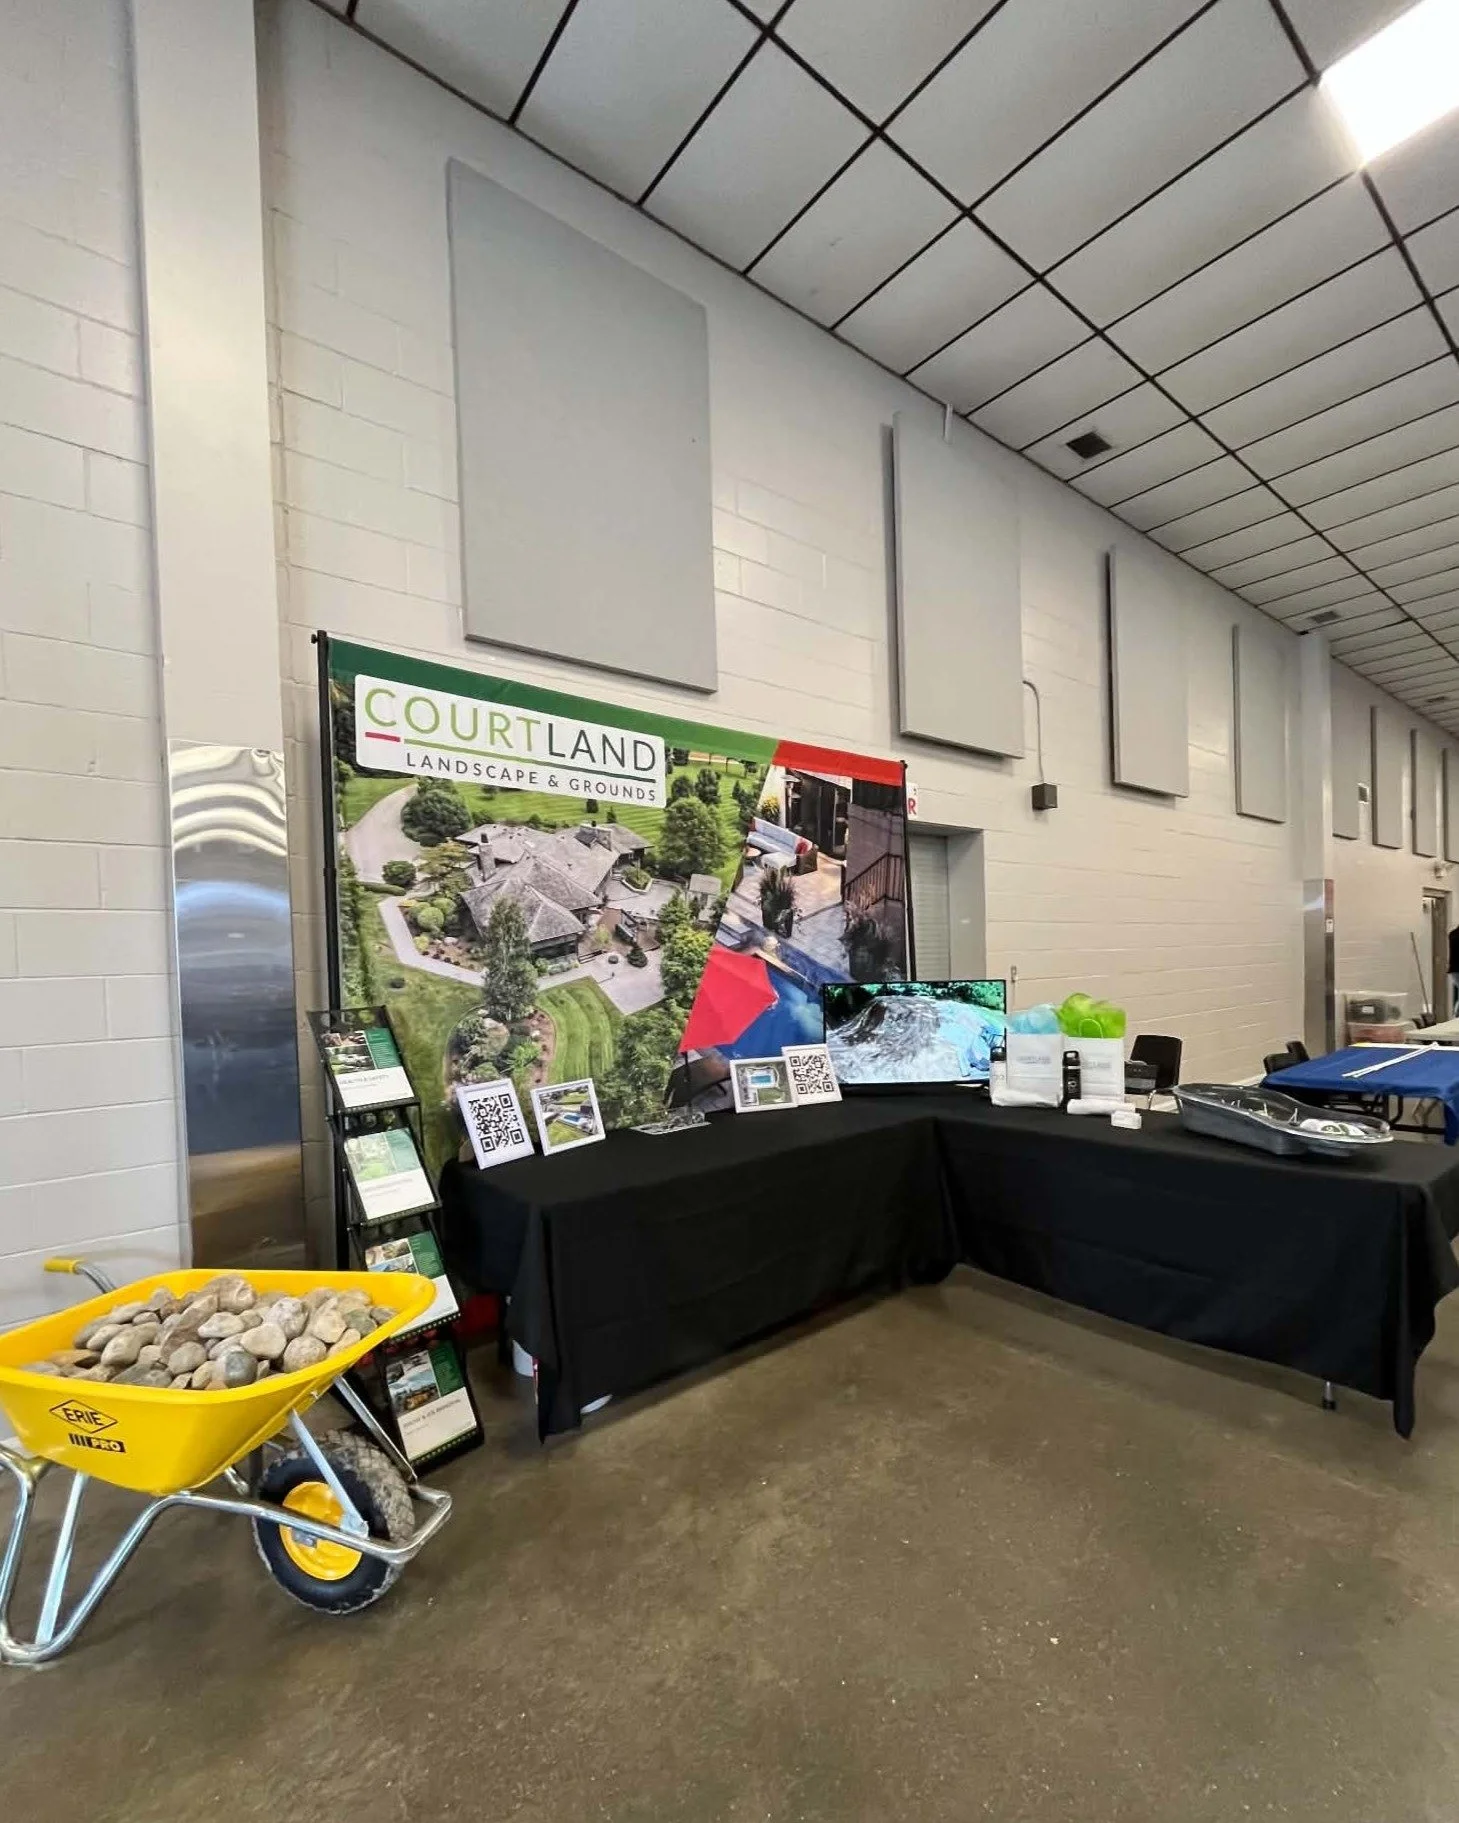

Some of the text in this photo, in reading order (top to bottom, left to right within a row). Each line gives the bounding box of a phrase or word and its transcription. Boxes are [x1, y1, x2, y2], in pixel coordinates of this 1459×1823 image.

[364, 688, 656, 772] COURTLAND
[406, 752, 656, 802] LANDSCAPE & GROUNDS
[62, 1407, 105, 1426] ERIE
[91, 1437, 122, 1452] PRO
